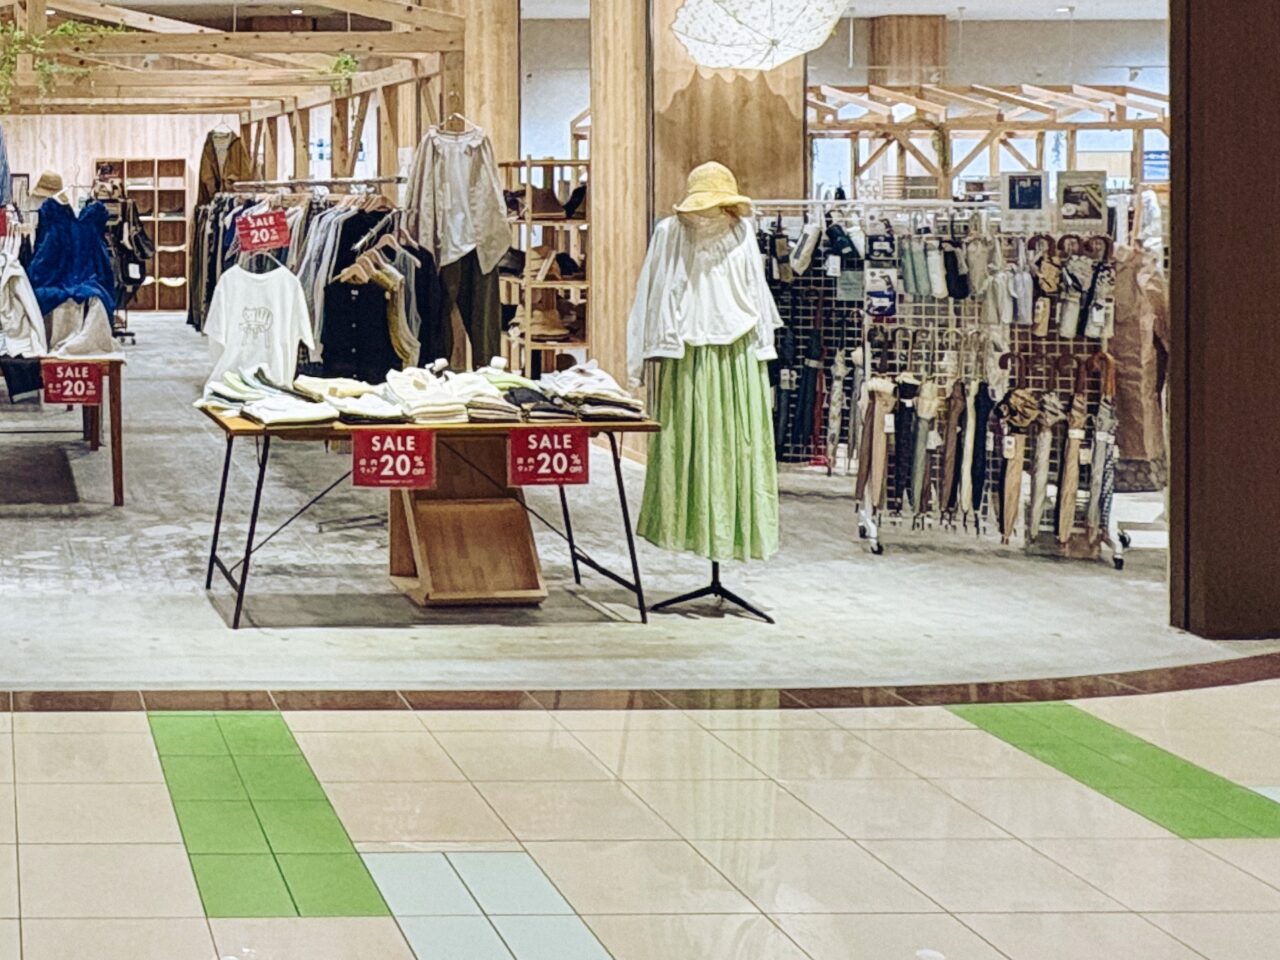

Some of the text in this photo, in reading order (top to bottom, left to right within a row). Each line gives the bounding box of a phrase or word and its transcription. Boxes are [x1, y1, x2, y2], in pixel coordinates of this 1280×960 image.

[248, 215, 276, 229] SALE
[56, 366, 89, 378] SALE
[371, 435, 416, 452] SALE
[527, 433, 573, 450] SALE
